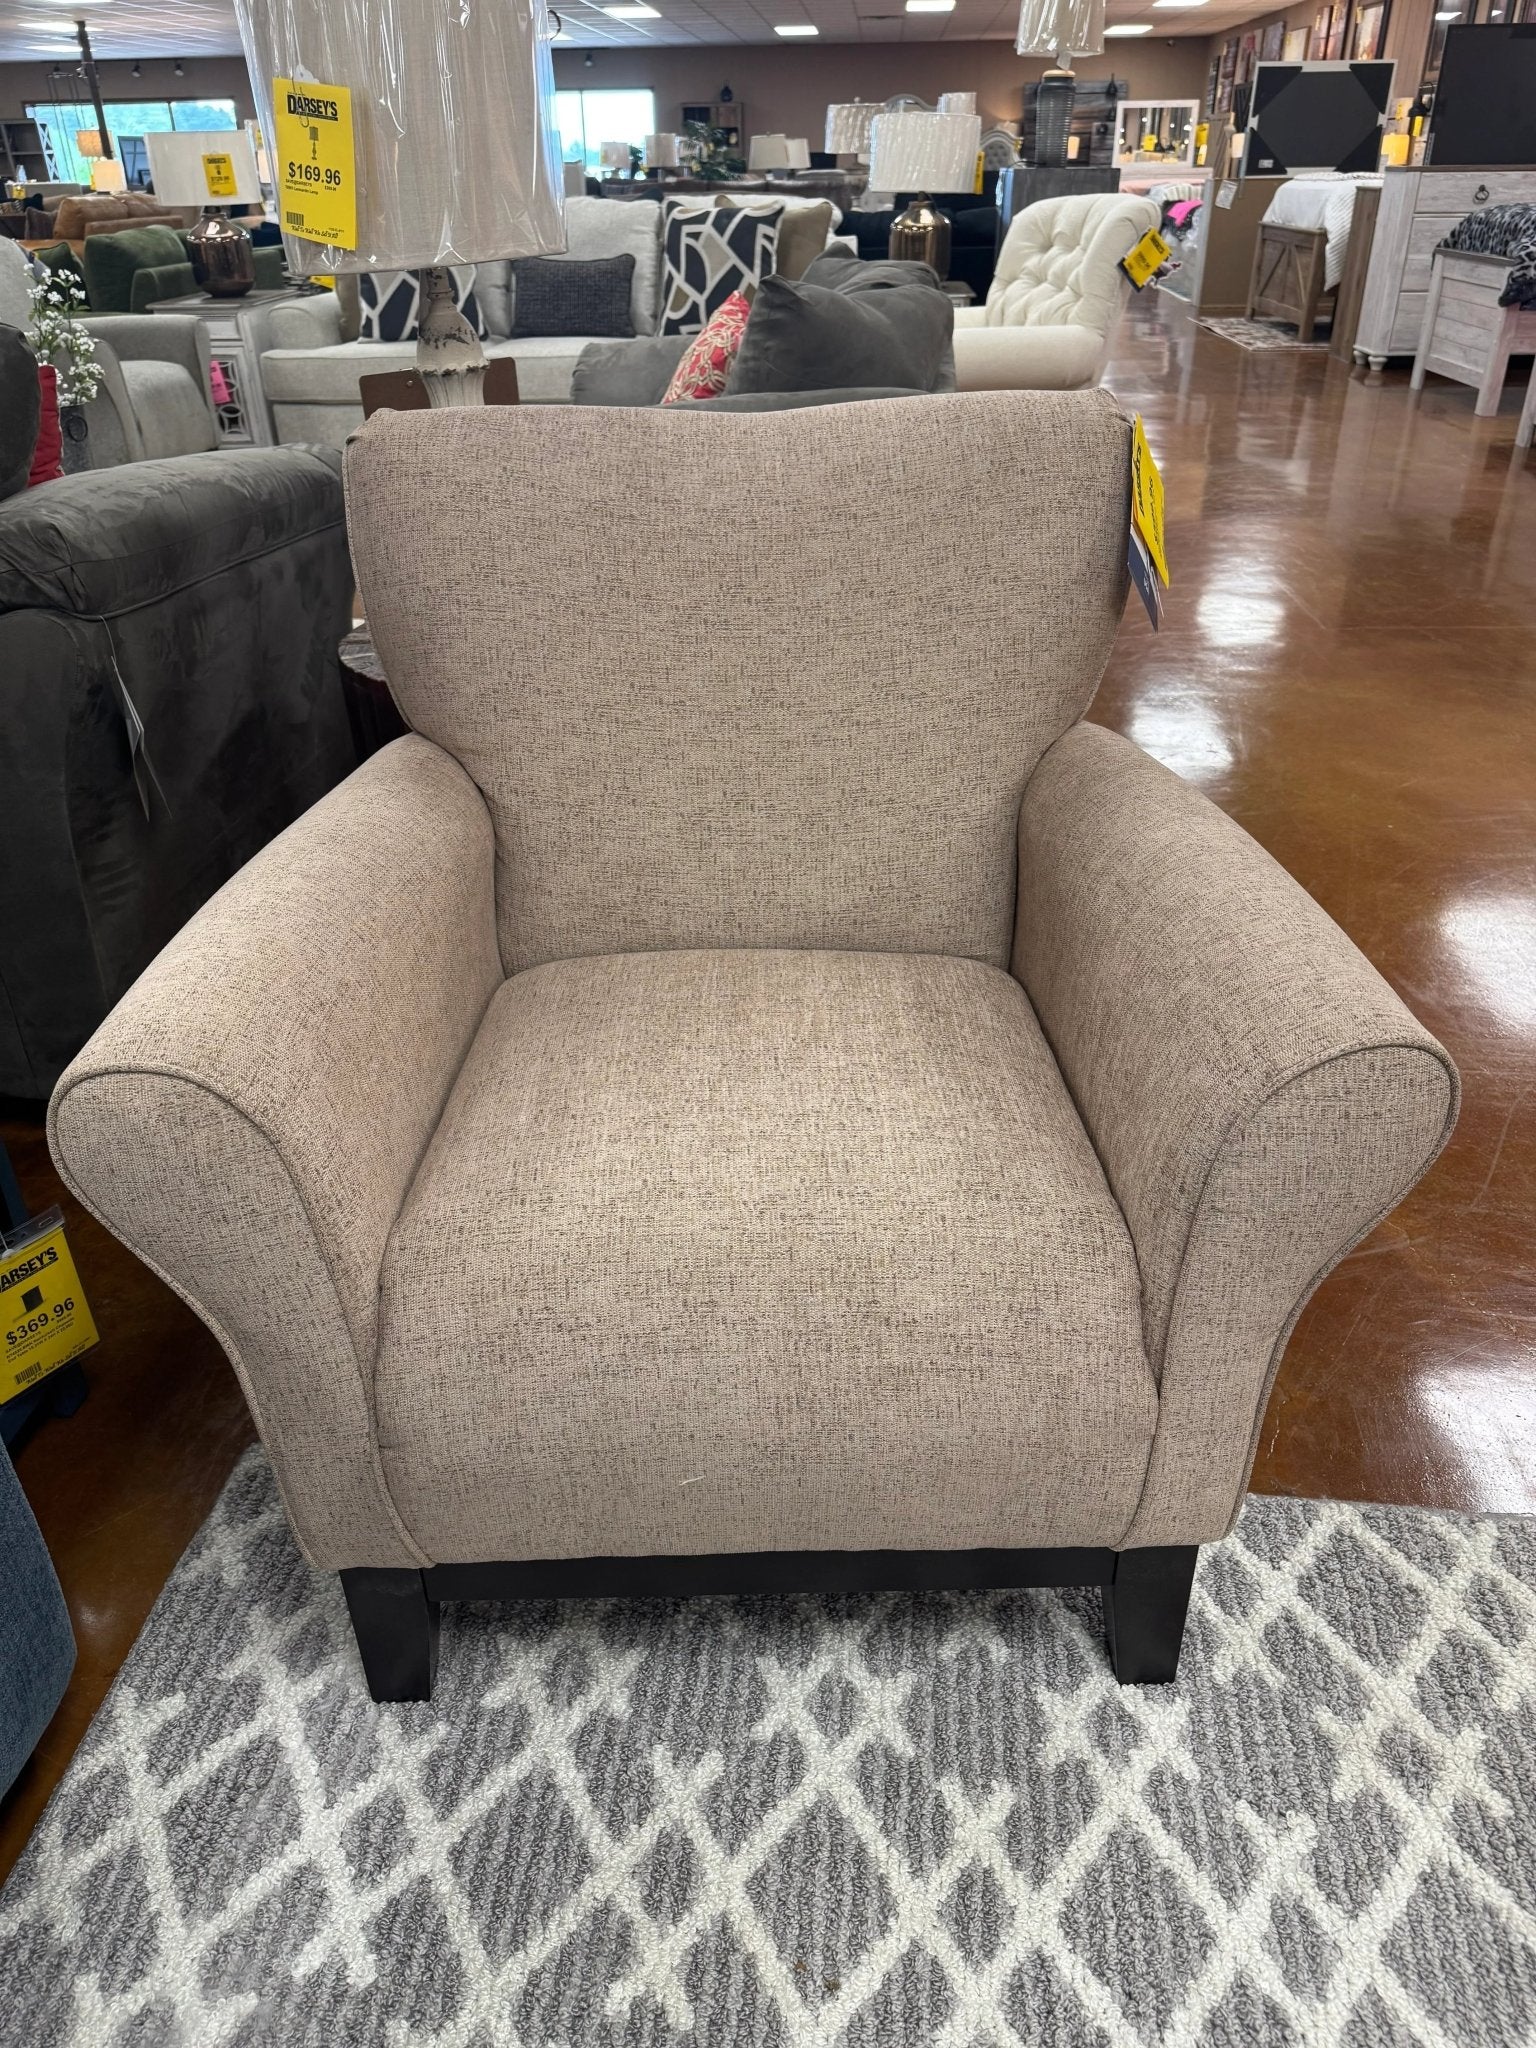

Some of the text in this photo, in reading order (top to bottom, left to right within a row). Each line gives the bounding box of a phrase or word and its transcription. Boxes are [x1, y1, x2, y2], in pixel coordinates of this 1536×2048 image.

[287, 94, 338, 117] DARSEY'S
[288, 161, 341, 186] $169.96
[0, 1246, 57, 1289] ARSEY'S
[6, 1297, 75, 1345] $369.96
